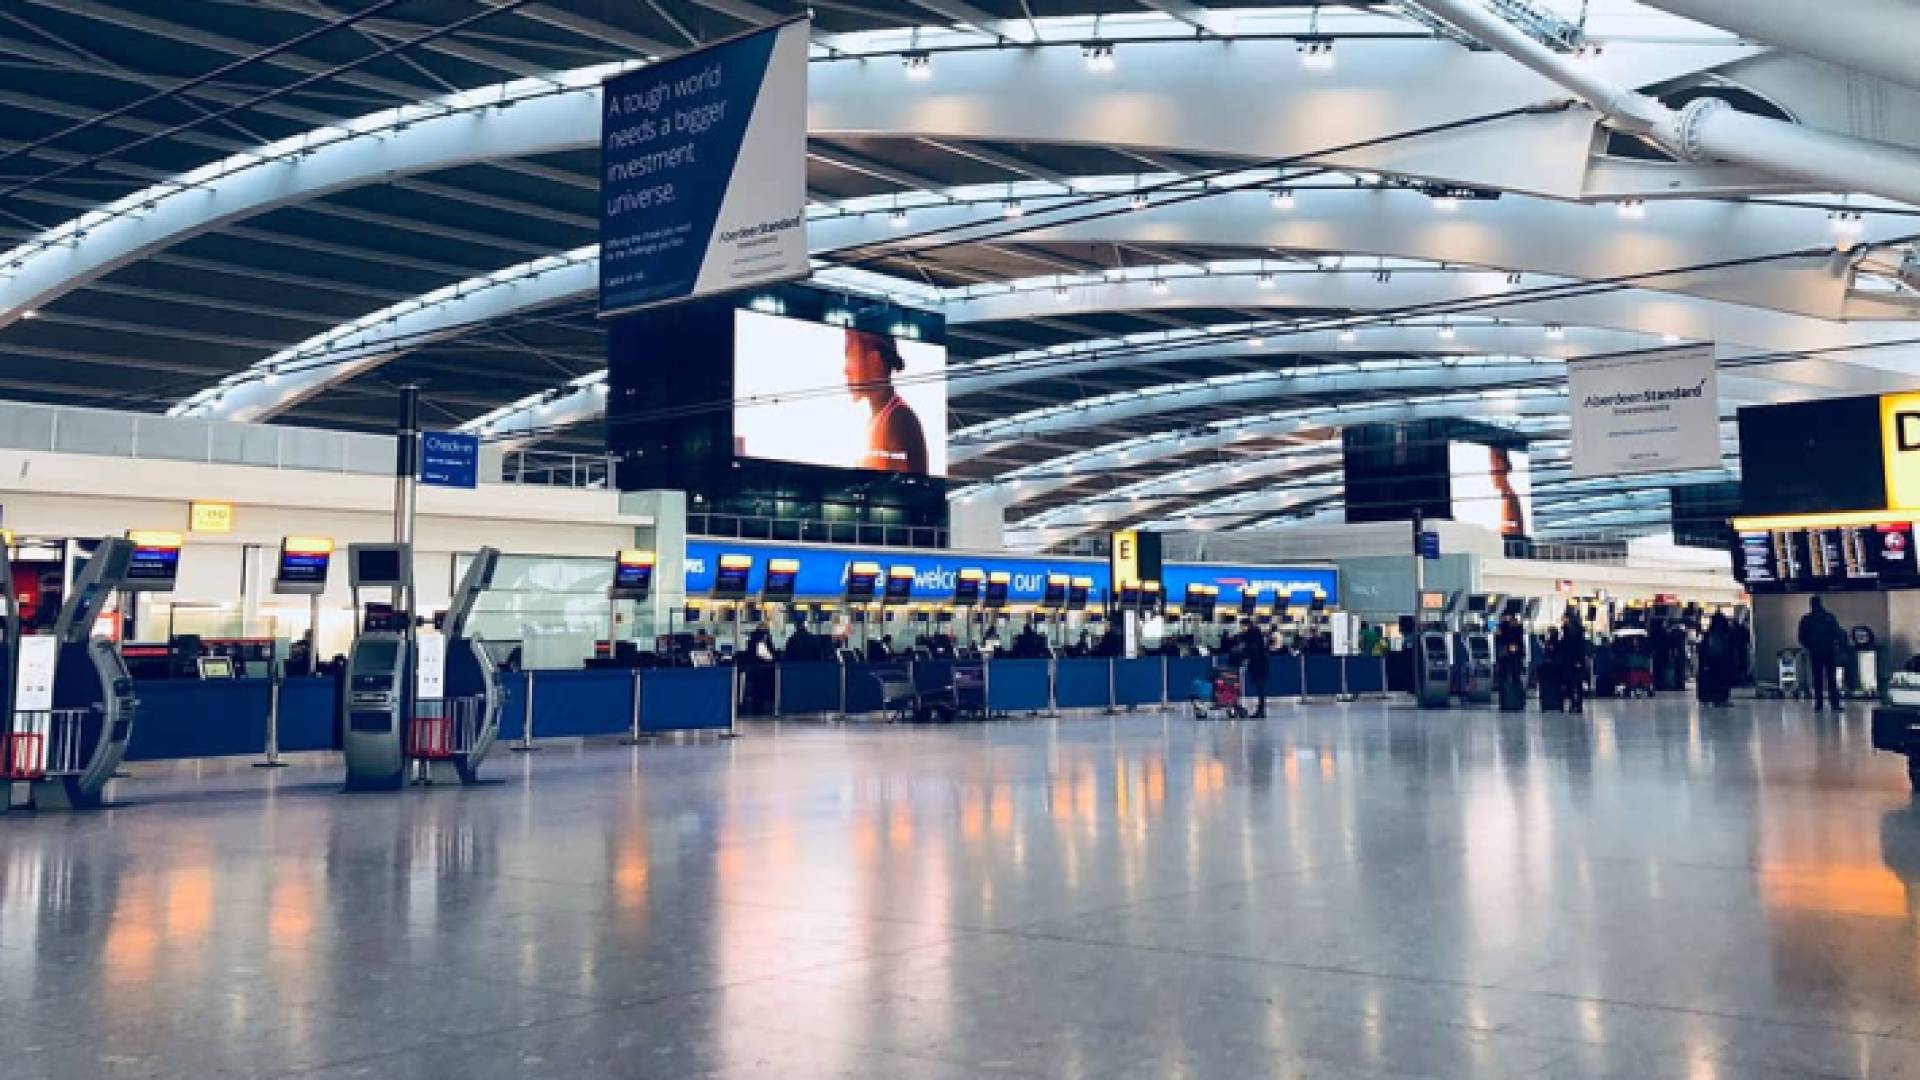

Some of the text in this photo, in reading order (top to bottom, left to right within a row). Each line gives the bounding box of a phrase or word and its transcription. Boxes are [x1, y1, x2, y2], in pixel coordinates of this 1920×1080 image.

[608, 62, 722, 117] A tough world
[608, 99, 727, 149] needs a bigger
[607, 142, 695, 182] investment
[1120, 539, 1131, 560] E
[1014, 574, 1042, 592] our
